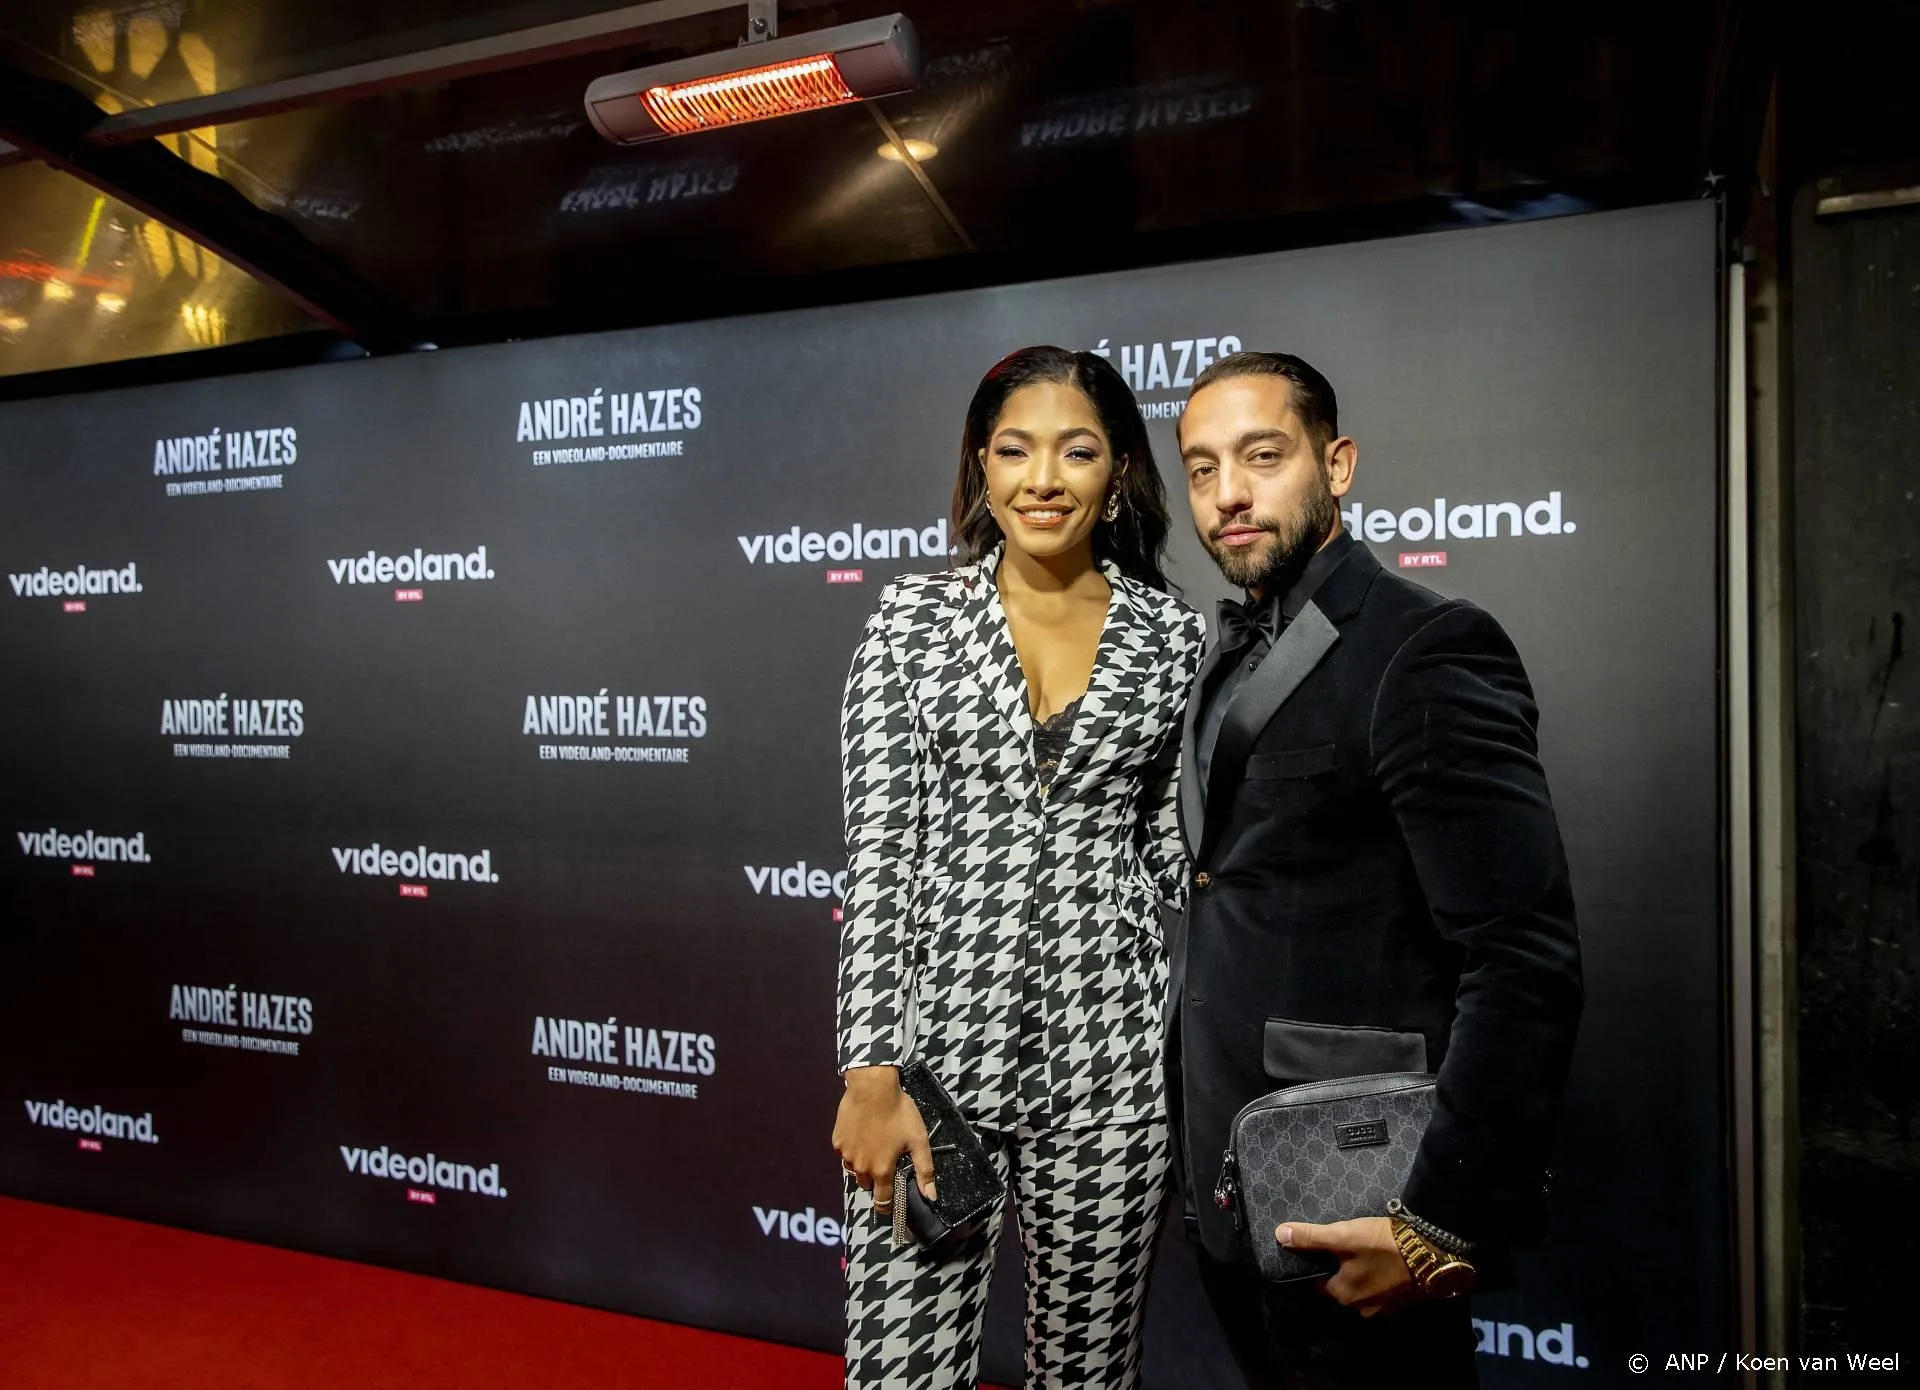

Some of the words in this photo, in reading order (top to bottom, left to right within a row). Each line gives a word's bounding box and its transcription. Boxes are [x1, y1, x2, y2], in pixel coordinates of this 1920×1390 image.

[517, 388, 604, 443] ANDRÉ
[609, 386, 703, 437] HAZES
[154, 426, 222, 477] ANDRÉ
[226, 426, 298, 470] HAZES
[532, 451, 551, 466] EEN
[552, 441, 684, 465] VIDEOLAND-DOCUMENTAIRE
[1341, 491, 1577, 543] deoland.
[8, 562, 143, 597] videoland.
[328, 546, 496, 585] videoland.
[830, 572, 842, 581] BY
[843, 571, 860, 581] RTL
[1403, 555, 1418, 565] BY
[1421, 554, 1443, 564] RTL
[161, 692, 229, 736] ANDRÉ
[233, 699, 304, 737] HAZES
[523, 687, 610, 736] ANDRÉ
[616, 695, 707, 738] HAZES
[539, 745, 557, 760] EEN
[558, 745, 689, 763] VIDEOLAND-DOCUMENTAIRE
[17, 828, 152, 863] videoland.
[332, 843, 500, 882] videoland.
[170, 983, 239, 1028] ANDRÉ
[242, 992, 314, 1035] HAZES
[531, 1015, 620, 1066] ANDRÉ
[623, 1027, 717, 1077] HAZES
[548, 1066, 567, 1082] EEN
[567, 1067, 698, 1099] VIDEOLAND-DOCUMENTAIRE
[25, 1099, 159, 1144] videoland.
[340, 1145, 508, 1198] videoland.
